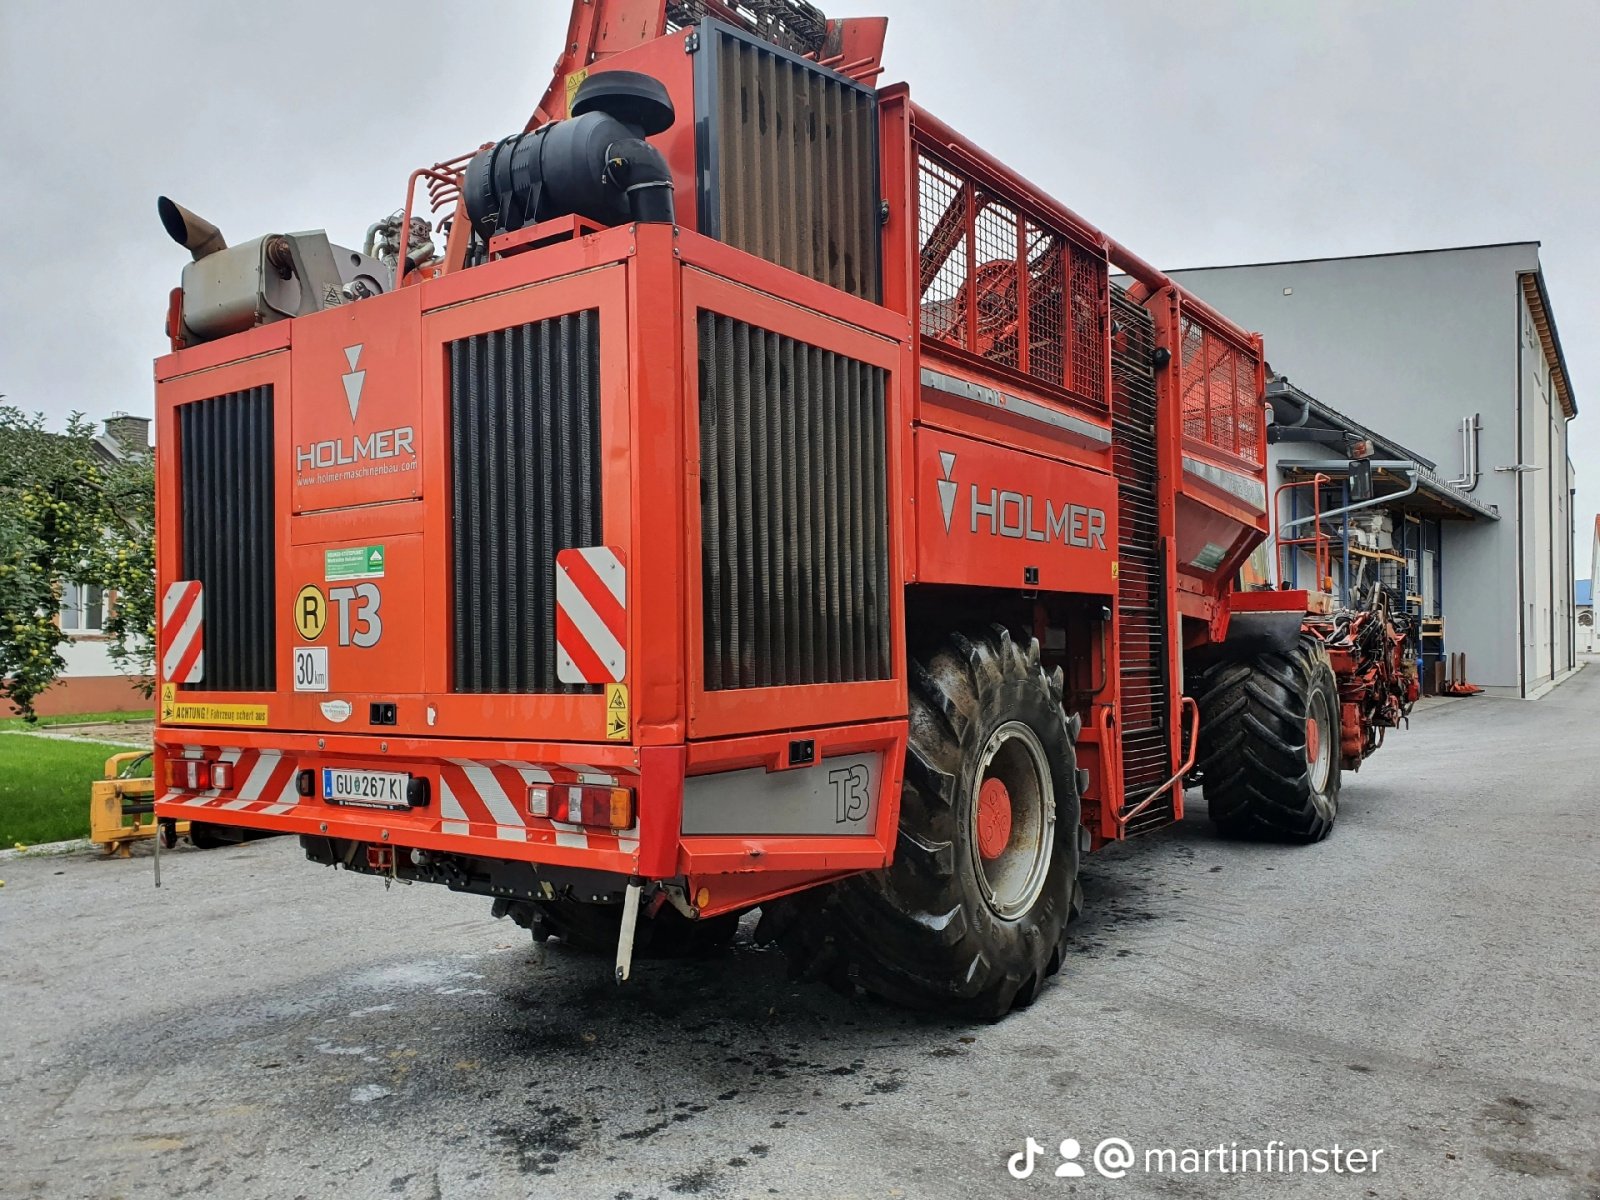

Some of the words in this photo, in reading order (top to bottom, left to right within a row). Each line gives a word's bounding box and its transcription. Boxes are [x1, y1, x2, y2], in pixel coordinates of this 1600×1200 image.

[296, 426, 416, 472] HOLMER
[970, 483, 1108, 550] HOLMER
[303, 596, 319, 629] R
[328, 582, 383, 648] T3
[297, 653, 314, 685] 30
[314, 671, 325, 685] km
[255, 712, 266, 721] aus
[336, 774, 353, 795] GU
[362, 776, 386, 799] 267
[828, 763, 870, 824] T3
